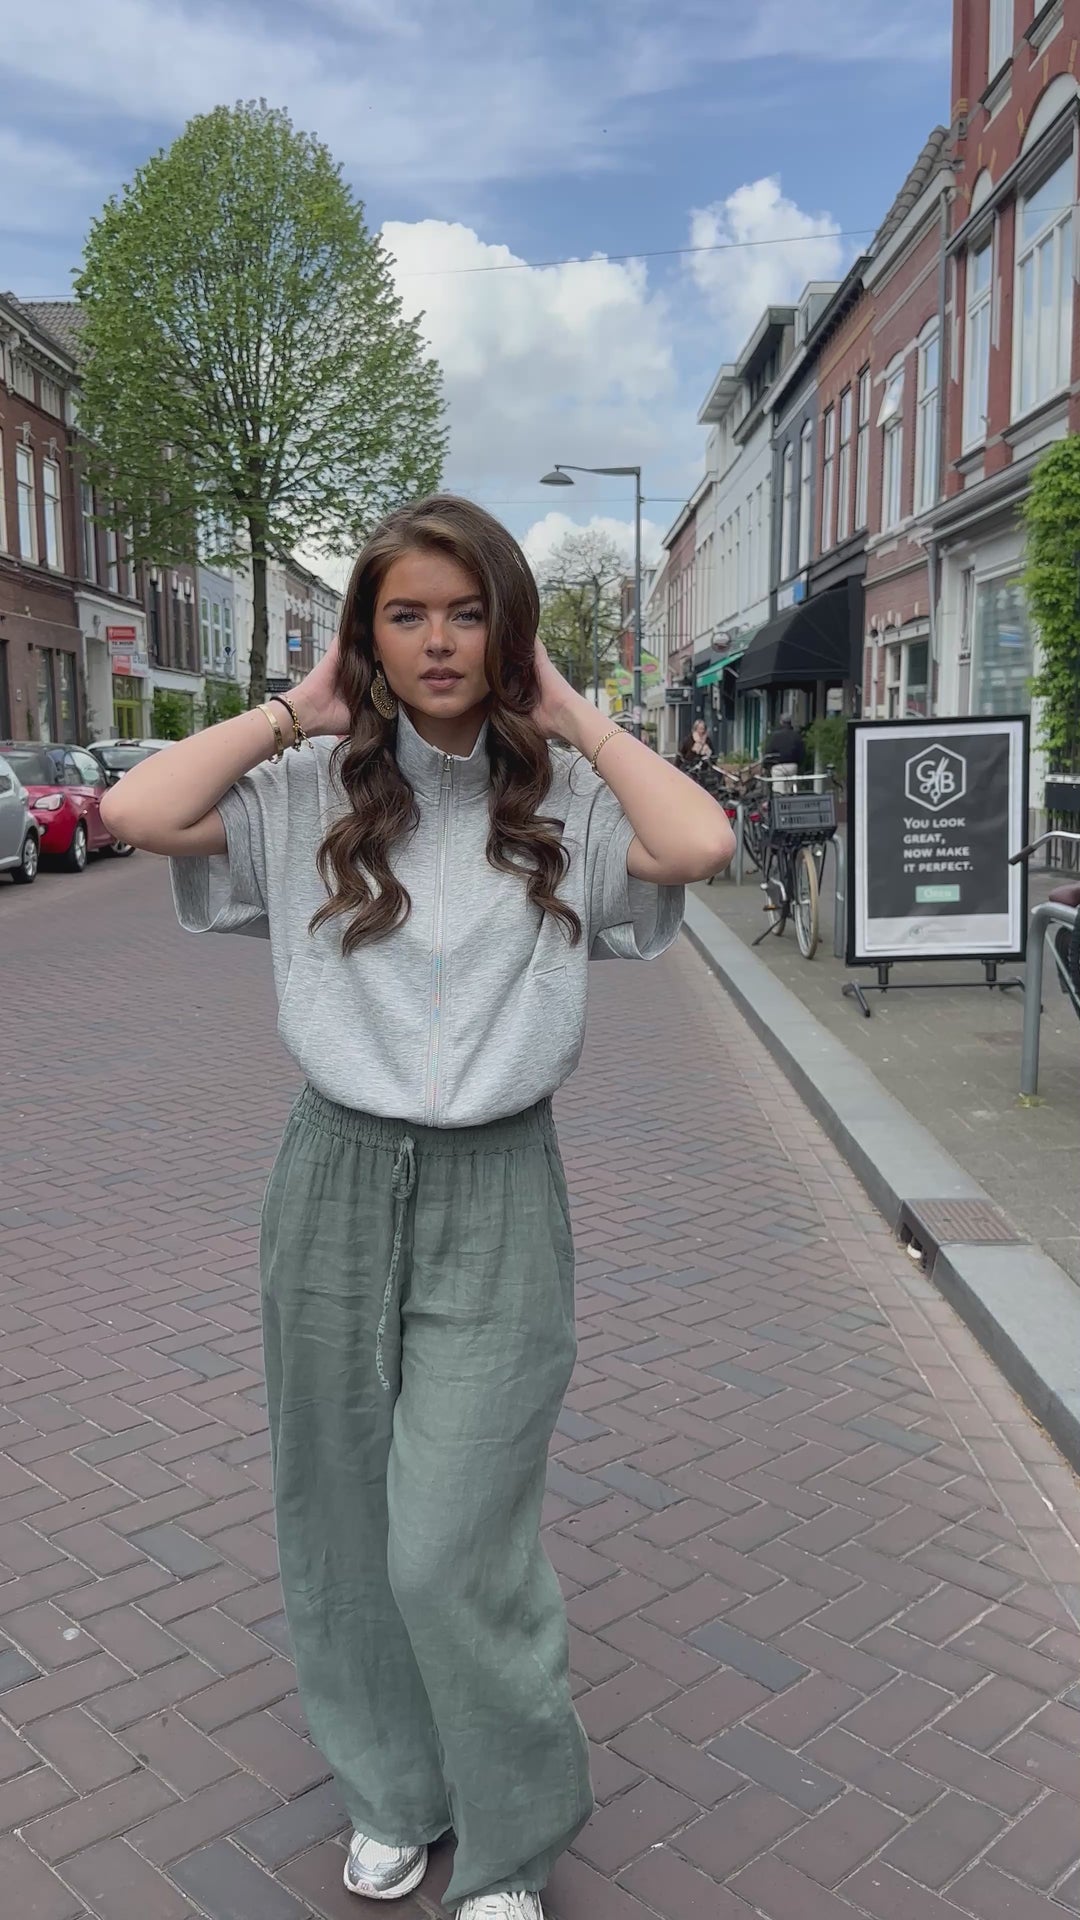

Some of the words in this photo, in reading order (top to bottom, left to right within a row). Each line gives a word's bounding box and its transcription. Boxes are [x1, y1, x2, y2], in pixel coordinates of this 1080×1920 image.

[933, 817, 966, 828] LOOK
[903, 833, 946, 845] GREAT,
[903, 848, 933, 858] NOW
[936, 846, 970, 857] MAKE
[903, 863, 915, 873] IT
[918, 861, 974, 872] PERFECT.
